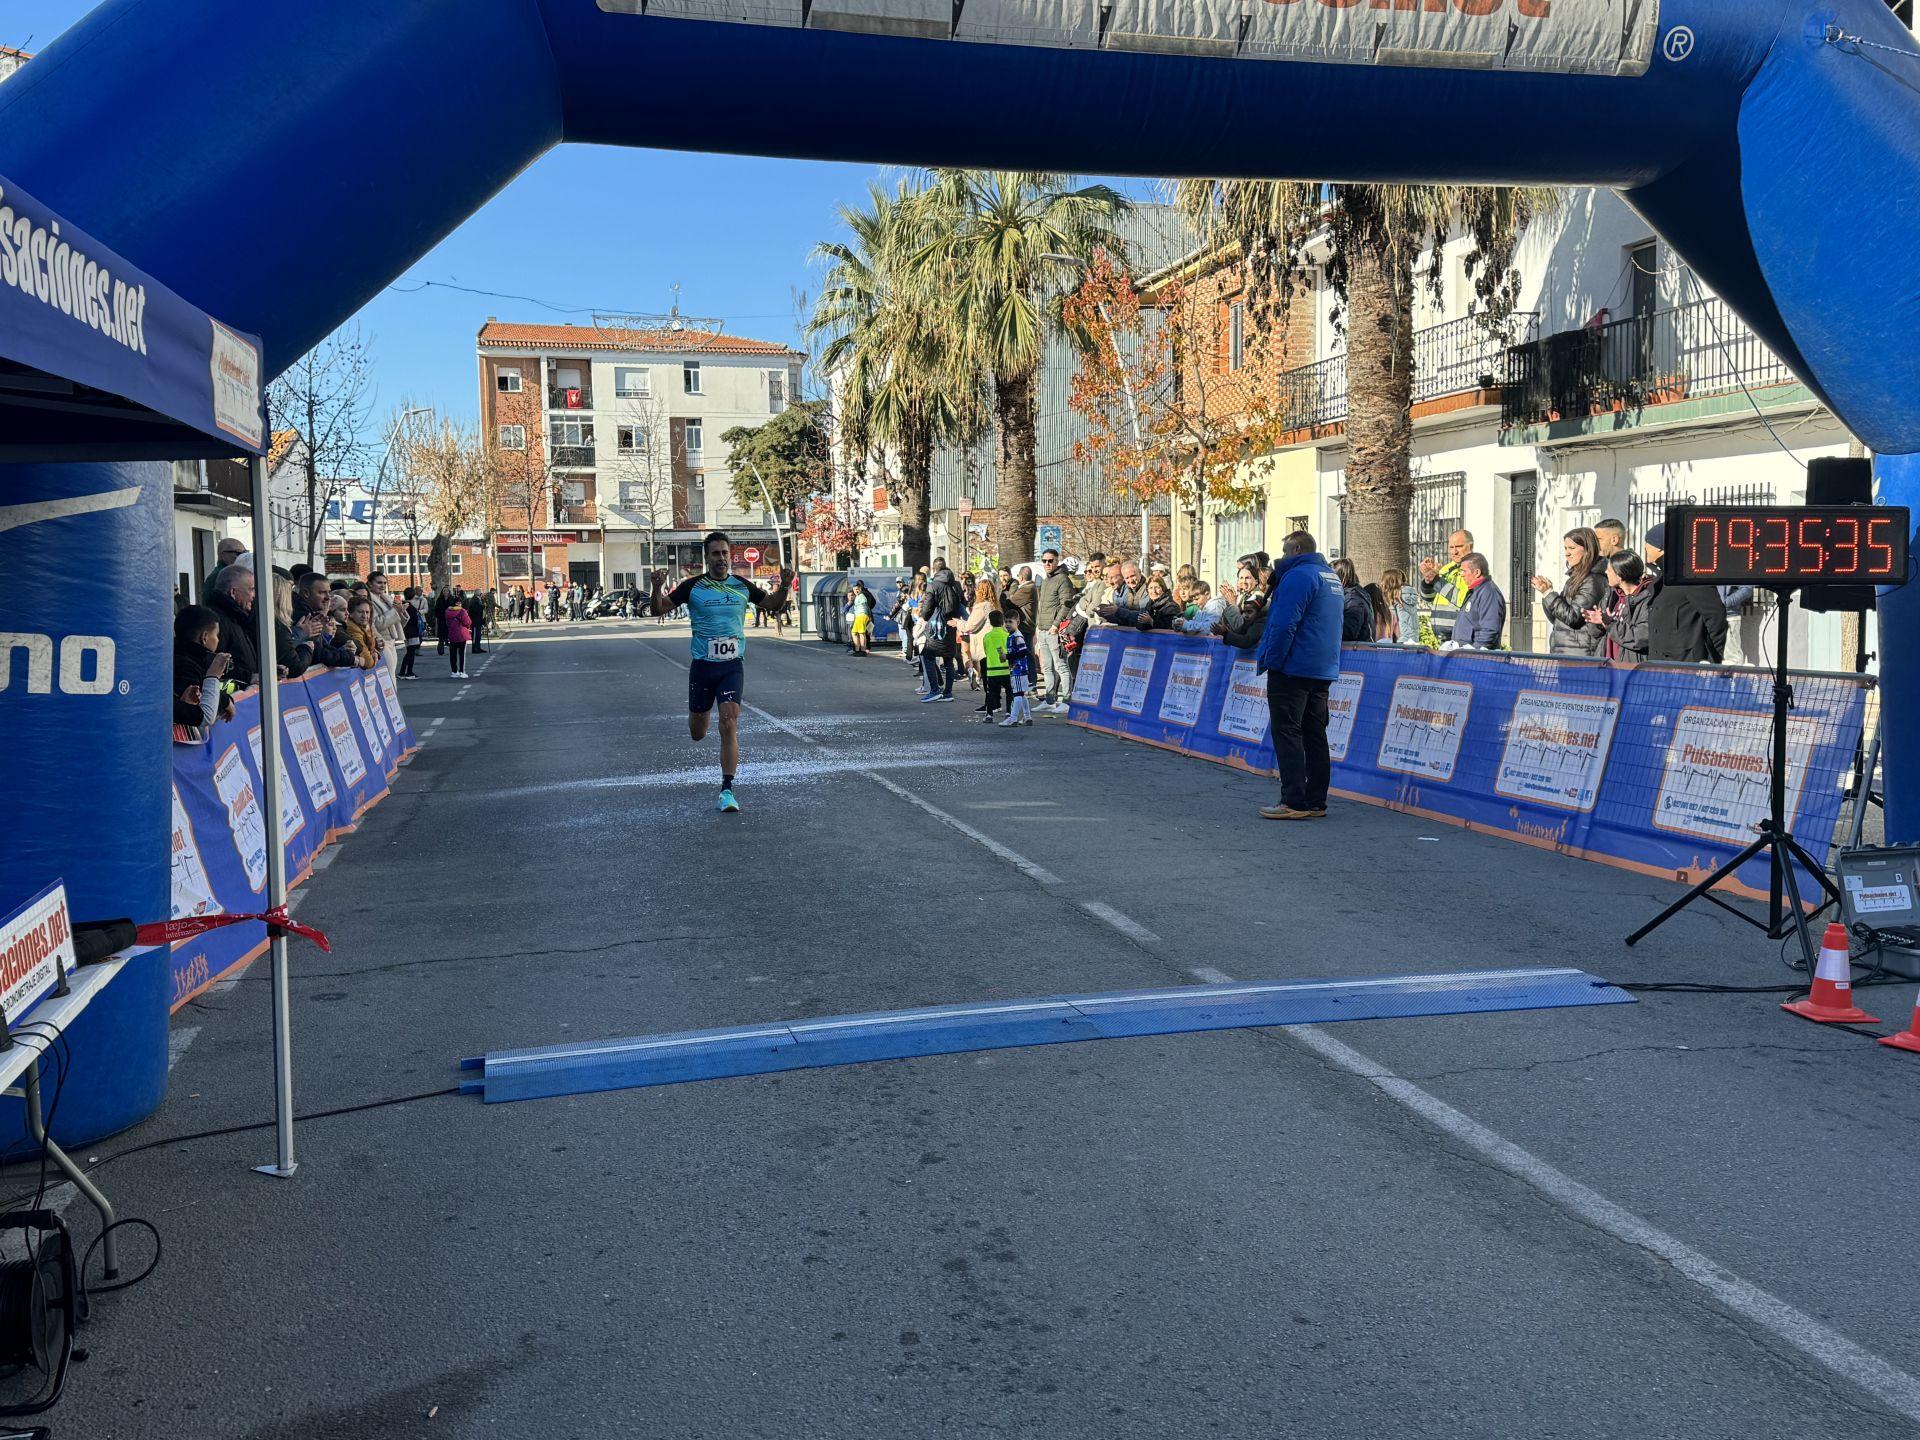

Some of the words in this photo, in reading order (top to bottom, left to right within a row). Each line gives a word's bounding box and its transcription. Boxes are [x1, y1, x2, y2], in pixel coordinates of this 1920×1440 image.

[0, 203, 147, 356] saciones.net
[520, 533, 563, 543] GNERALI
[1692, 517, 1892, 574] 09:35:35
[713, 642, 735, 655] 104
[1395, 703, 1458, 726] Pulsaciones.net
[1520, 697, 1554, 708] ORGANIZACIÓN
[1555, 701, 1562, 709] DE
[1561, 702, 1583, 712] EVENTOS
[1584, 704, 1615, 715] DEPORTIVOS
[1683, 715, 1728, 728] ORGANIZACIÓN
[1729, 721, 1738, 730] DE
[1518, 721, 1600, 749] Pulsaciones.net
